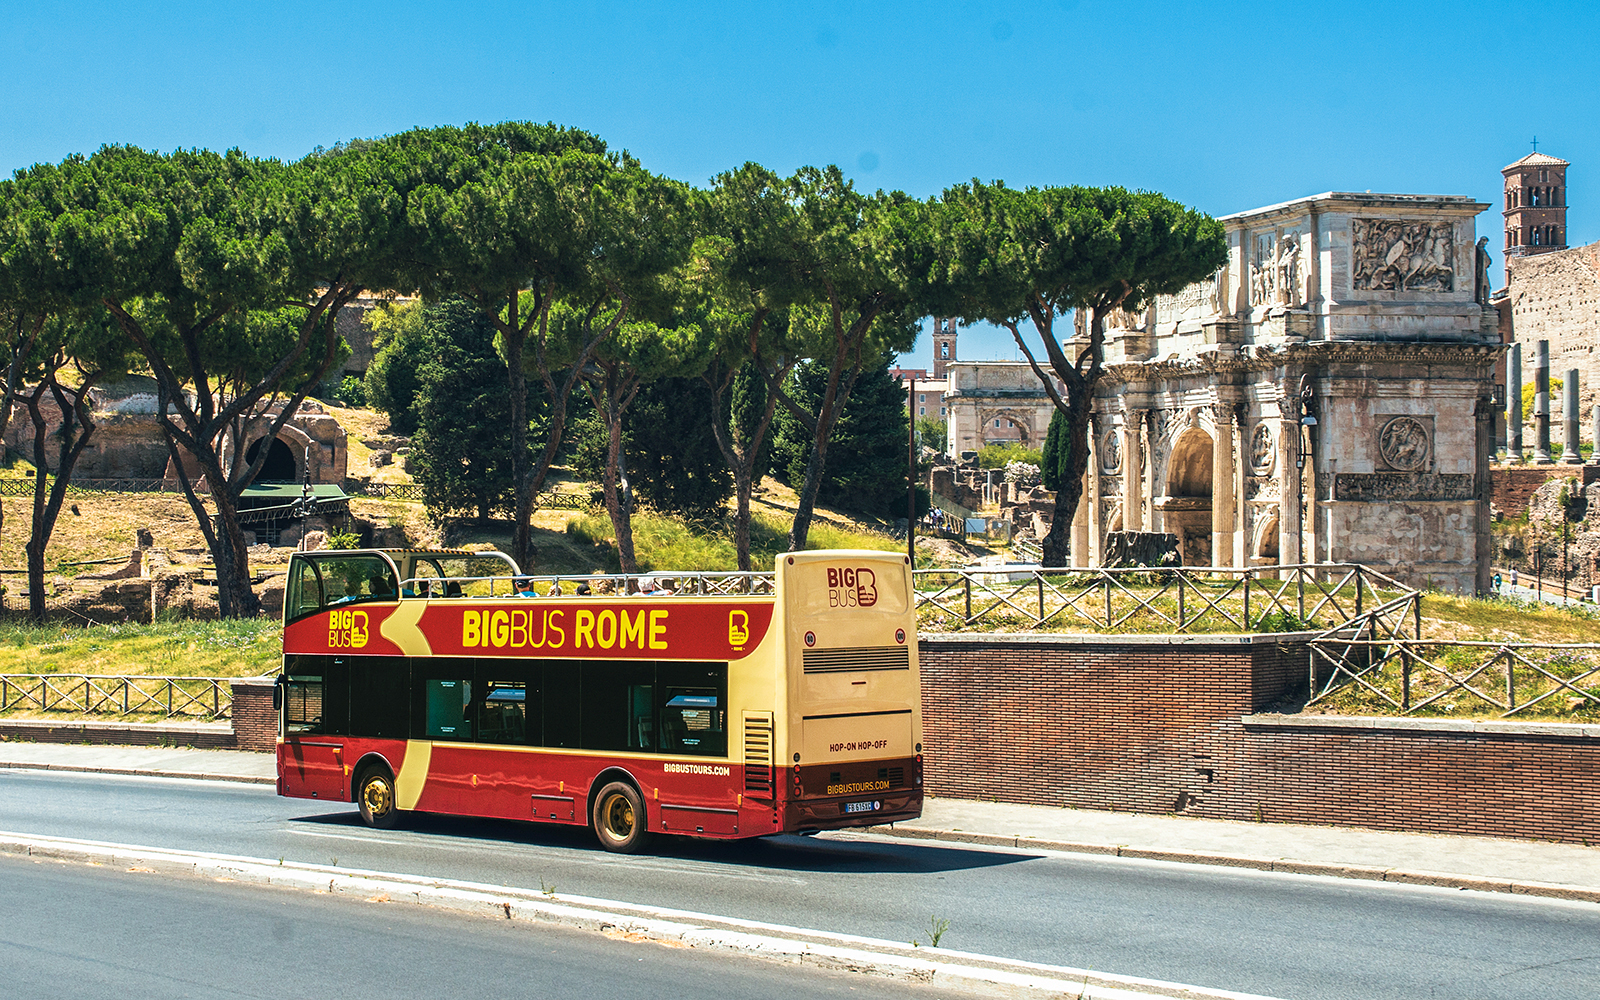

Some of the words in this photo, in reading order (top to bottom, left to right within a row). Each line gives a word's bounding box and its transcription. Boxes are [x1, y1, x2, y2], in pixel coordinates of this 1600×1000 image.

[827, 568, 855, 588] BIG
[828, 589, 857, 608] BUS
[329, 610, 352, 630] BIG
[575, 609, 669, 650] ROME
[328, 630, 351, 648] BUS
[829, 742, 857, 753] HOP-ON
[857, 739, 888, 751] HOP-OFF
[663, 763, 730, 777] BIGBUSTOURS.COM
[827, 780, 890, 795] BIGBUSTOURS.COM
